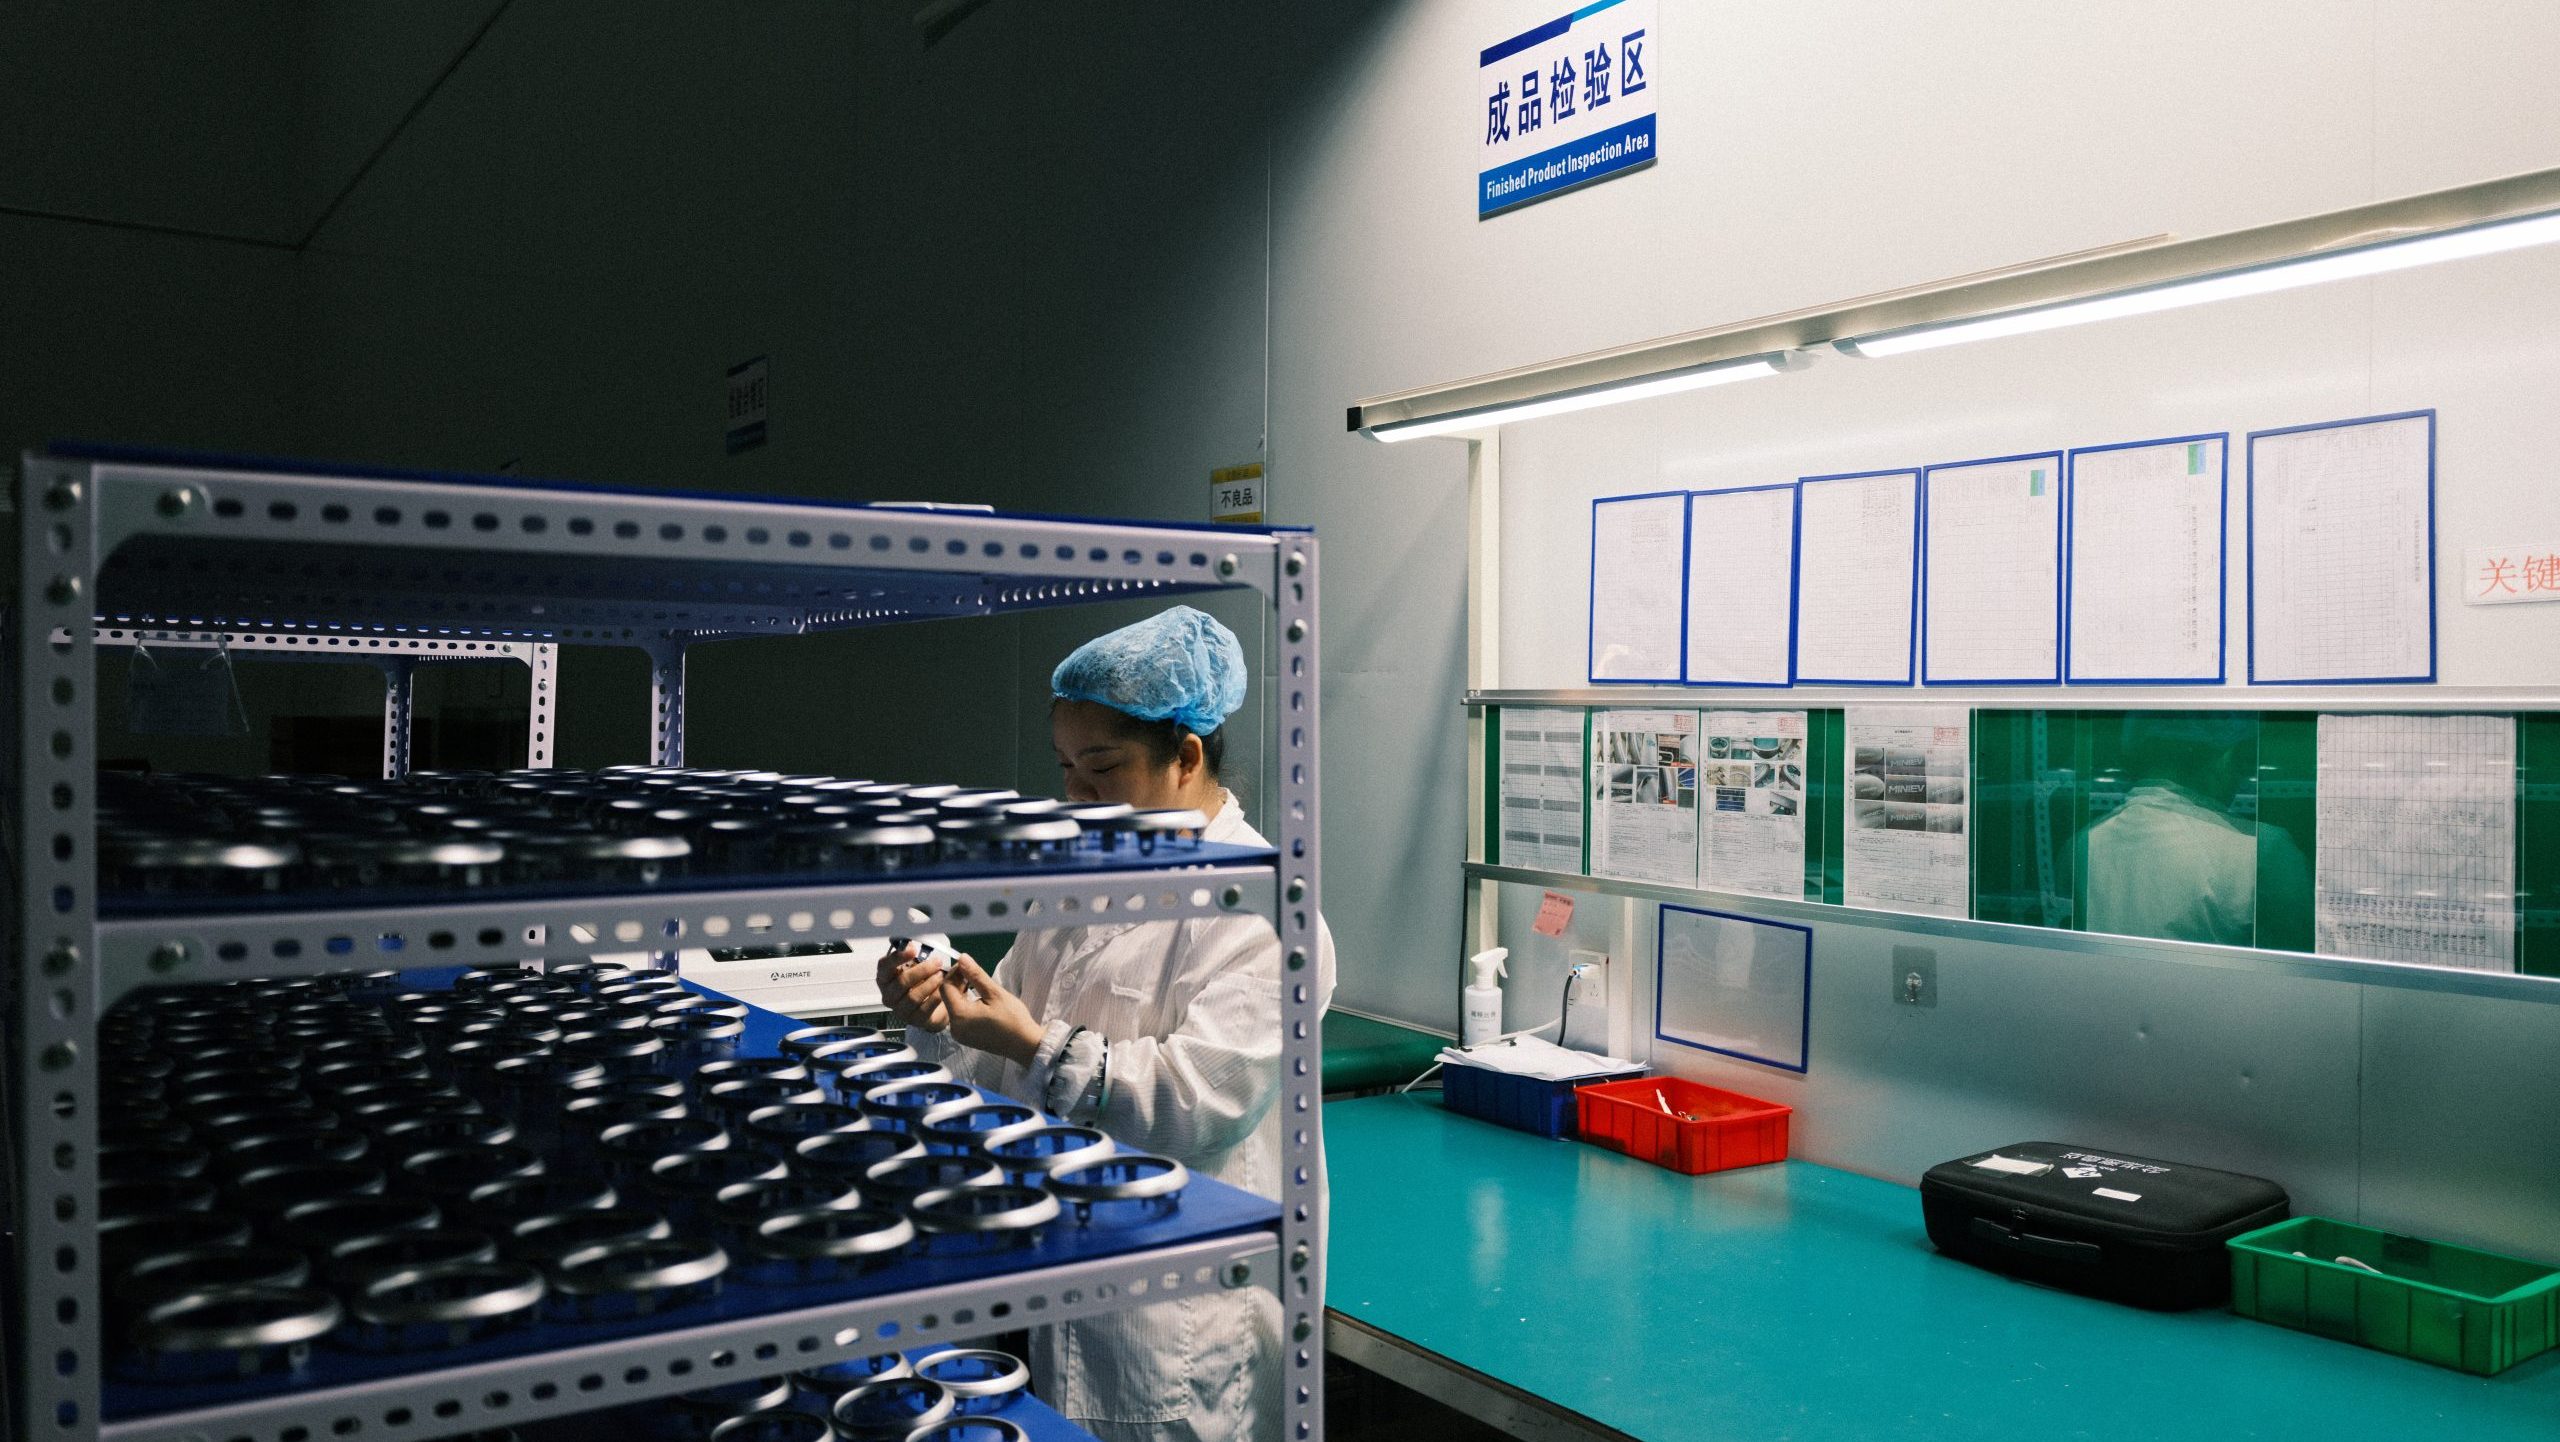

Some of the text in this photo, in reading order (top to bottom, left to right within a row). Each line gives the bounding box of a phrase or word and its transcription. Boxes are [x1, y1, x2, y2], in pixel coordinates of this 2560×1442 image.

[1487, 28, 1646, 145] 成品检验区
[1487, 133, 1649, 199] Finished Product Inspection Area
[1220, 487, 1253, 509] 不良品
[2479, 553, 2560, 597] 关键
[780, 971, 811, 979] AIRMATE
